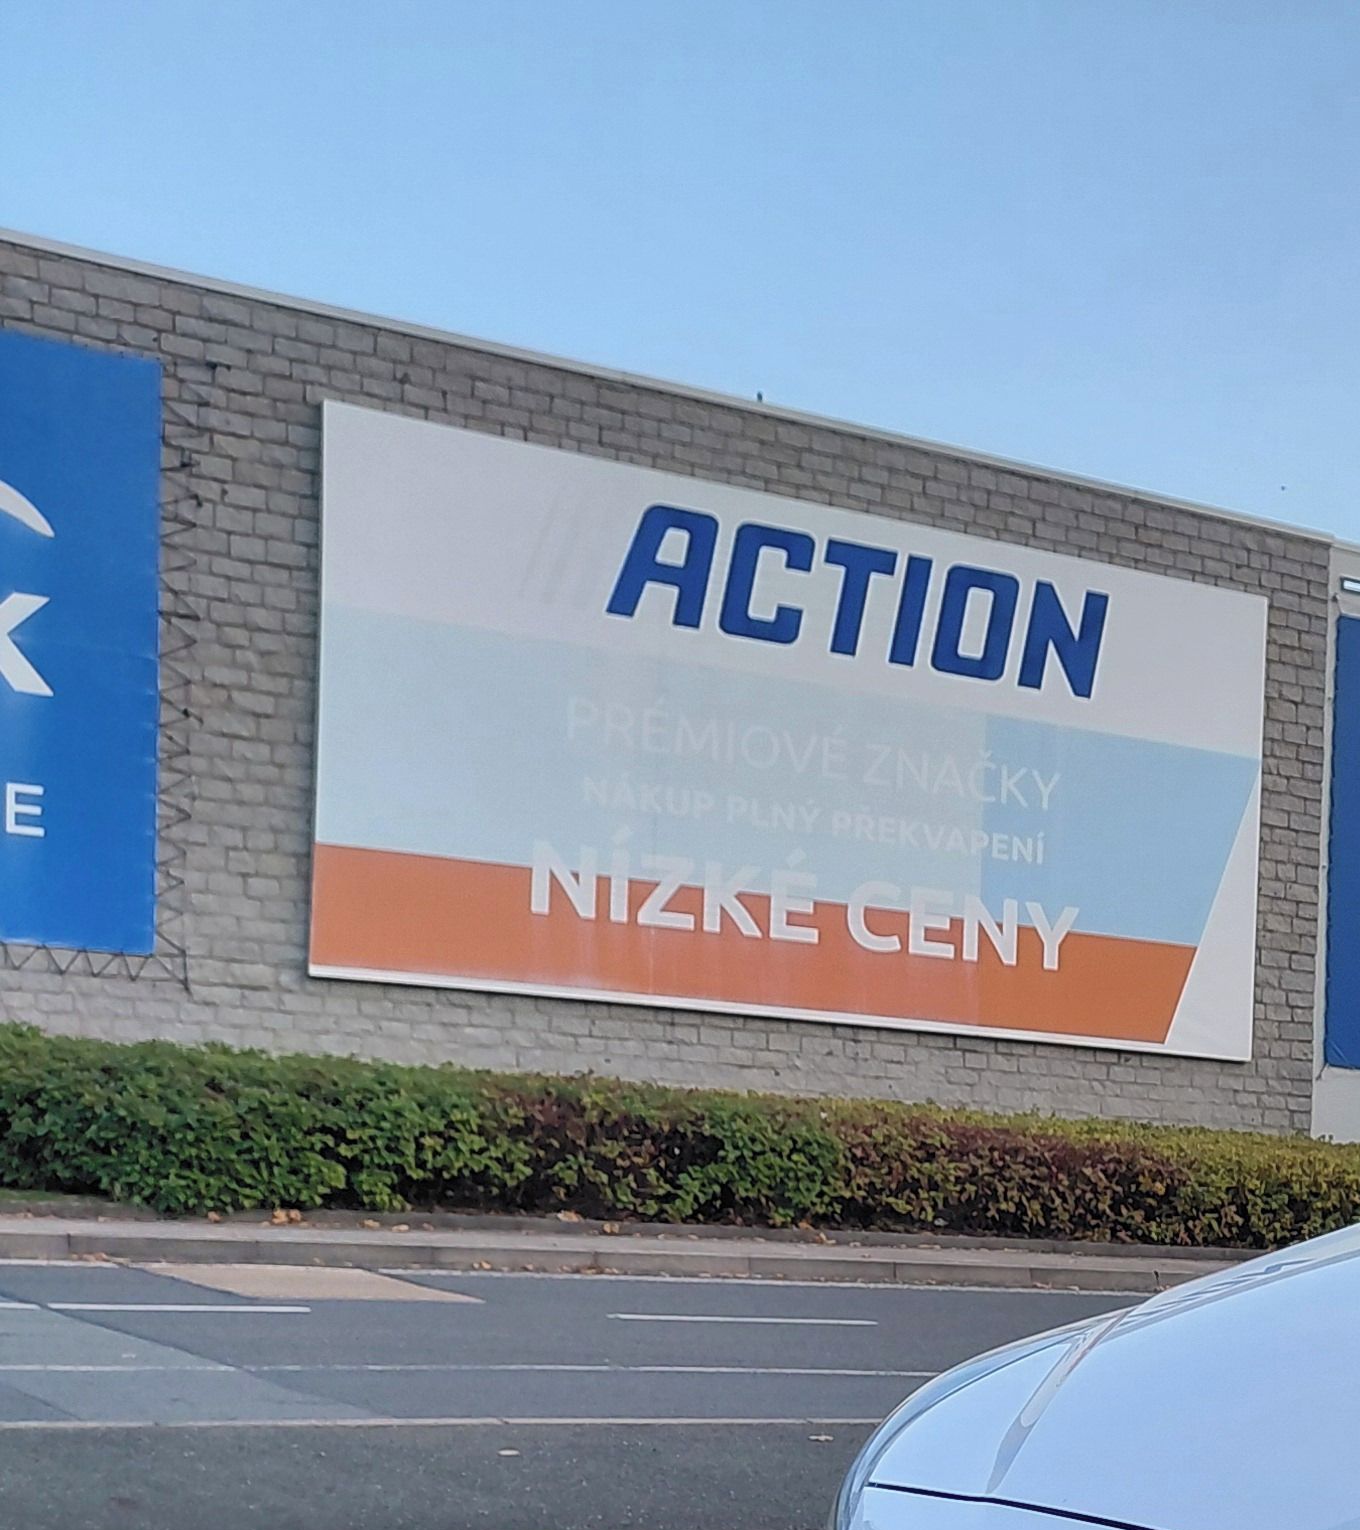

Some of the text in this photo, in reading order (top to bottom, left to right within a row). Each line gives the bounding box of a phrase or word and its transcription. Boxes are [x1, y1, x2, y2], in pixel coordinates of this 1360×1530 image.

[604, 503, 1109, 700] ACTION
[564, 693, 1063, 812] PRÉMIOVÉ ZNAČKY
[582, 771, 1046, 866] NÁKUP PLNÝ PŘEKVAPENÍ
[530, 824, 1080, 971] NÍZKÉ CENY
